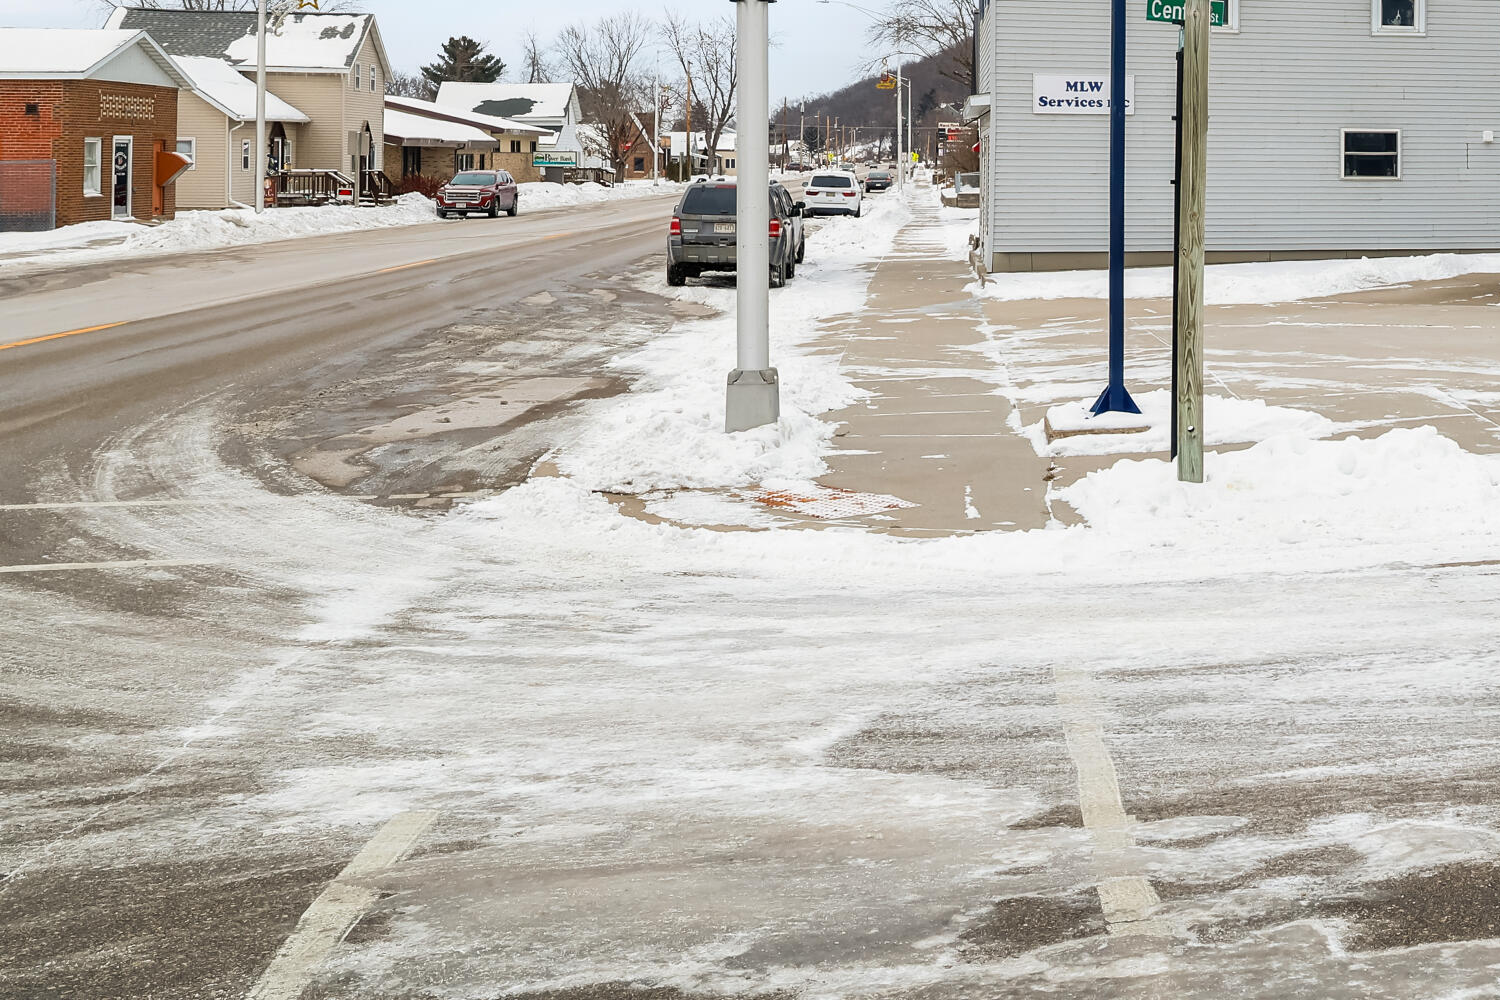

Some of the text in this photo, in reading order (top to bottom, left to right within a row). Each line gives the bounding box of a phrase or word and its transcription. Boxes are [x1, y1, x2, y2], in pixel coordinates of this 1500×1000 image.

[1210, 12, 1219, 23] St
[1065, 81, 1104, 92] MLW
[1038, 96, 1104, 108] Services
